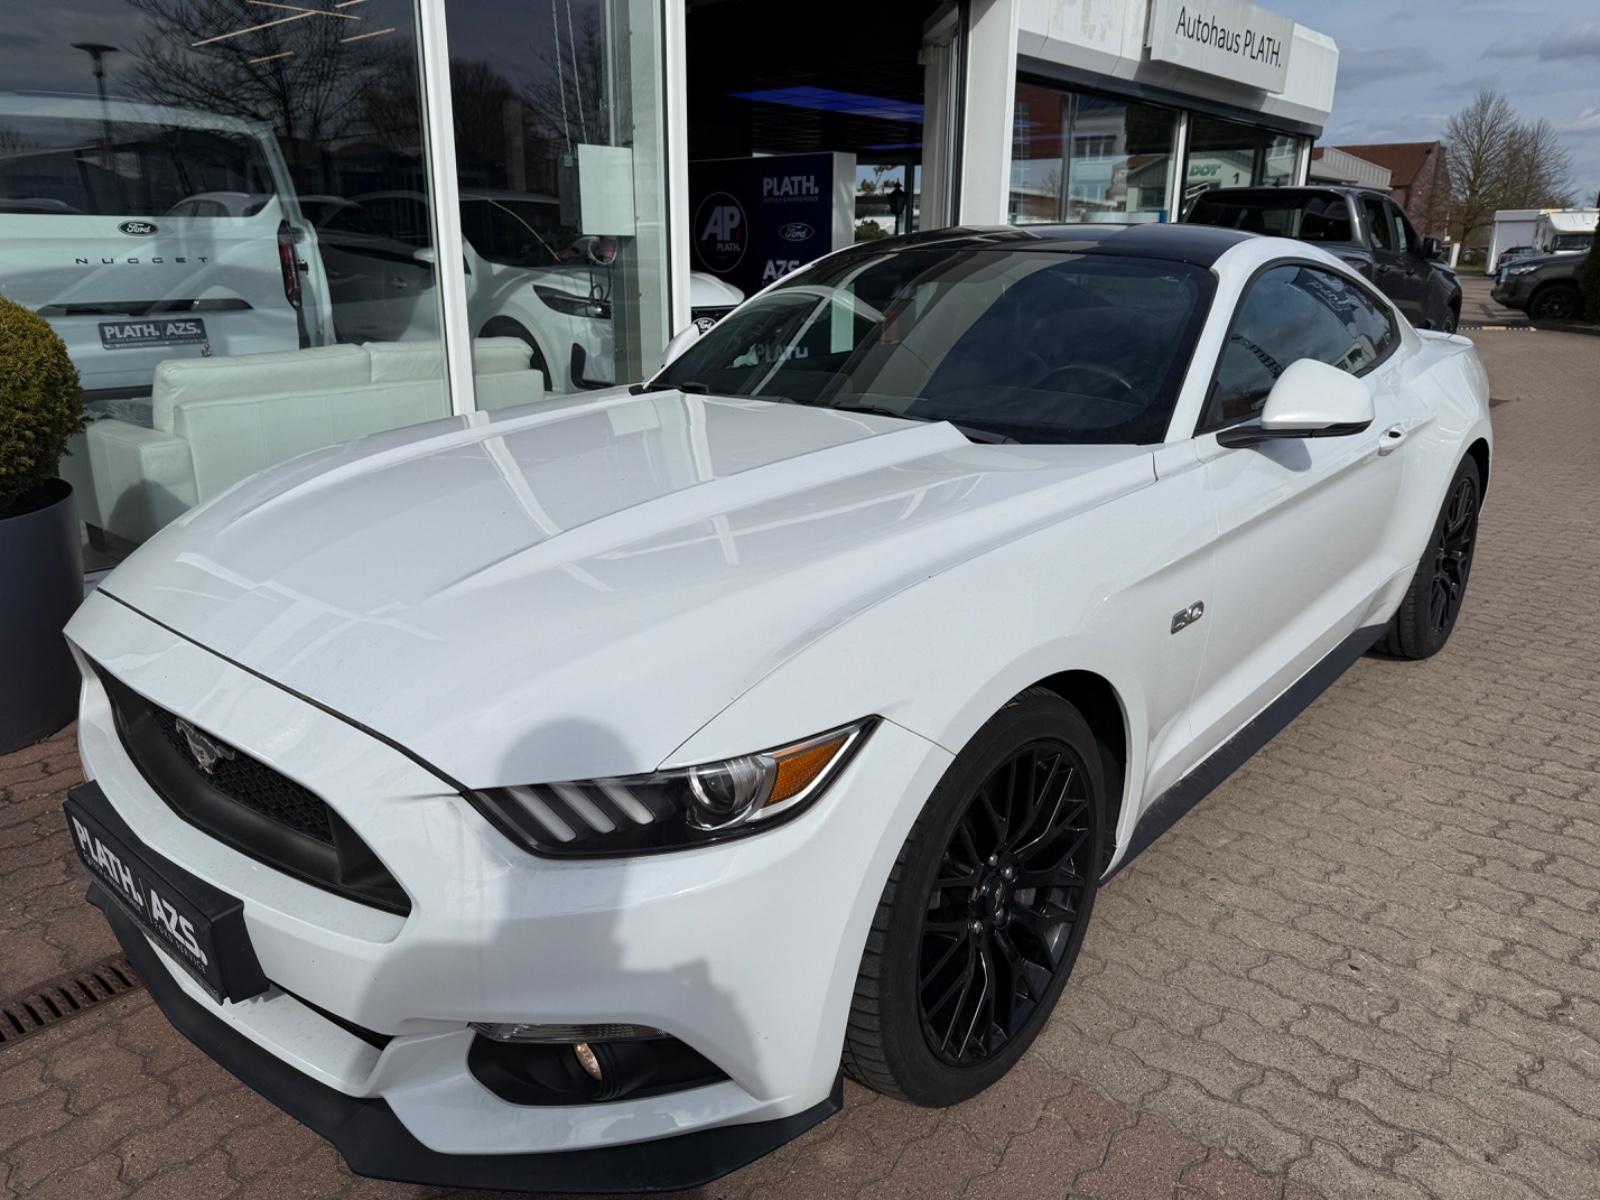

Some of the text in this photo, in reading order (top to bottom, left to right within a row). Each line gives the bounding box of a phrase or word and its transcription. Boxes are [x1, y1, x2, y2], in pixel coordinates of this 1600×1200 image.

[1175, 5, 1282, 69] Autohaus PLATH.
[762, 175, 820, 197] PLATH.
[1232, 171, 1240, 185] 1
[126, 222, 152, 234] Ford
[784, 225, 809, 239] Ford
[75, 257, 208, 265] NUGGET
[103, 324, 161, 339] PLATH.
[165, 322, 202, 336] AZS.
[1170, 600, 1205, 635] 5.0
[72, 816, 144, 907] PLATH.
[151, 888, 208, 966] AZS.
